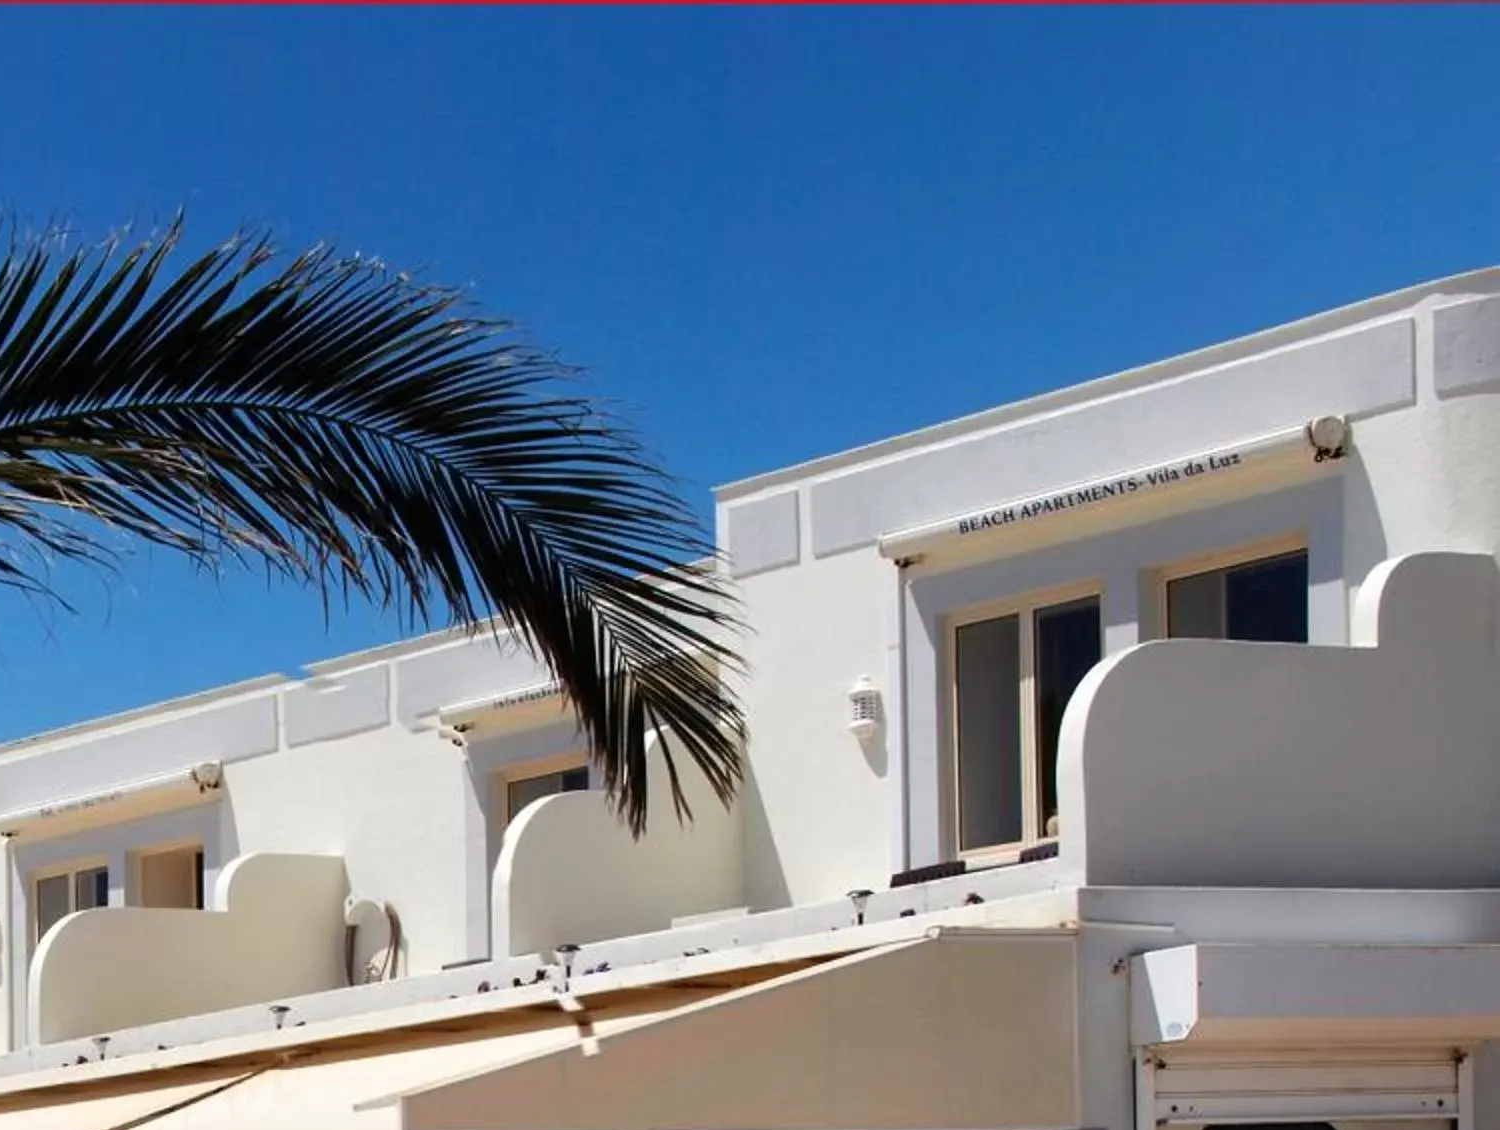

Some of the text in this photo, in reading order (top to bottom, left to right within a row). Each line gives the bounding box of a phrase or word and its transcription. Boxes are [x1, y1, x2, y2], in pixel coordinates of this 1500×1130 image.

[958, 509, 1016, 534] BEACH
[1184, 461, 1205, 477] da
[1208, 453, 1241, 471] Luz
